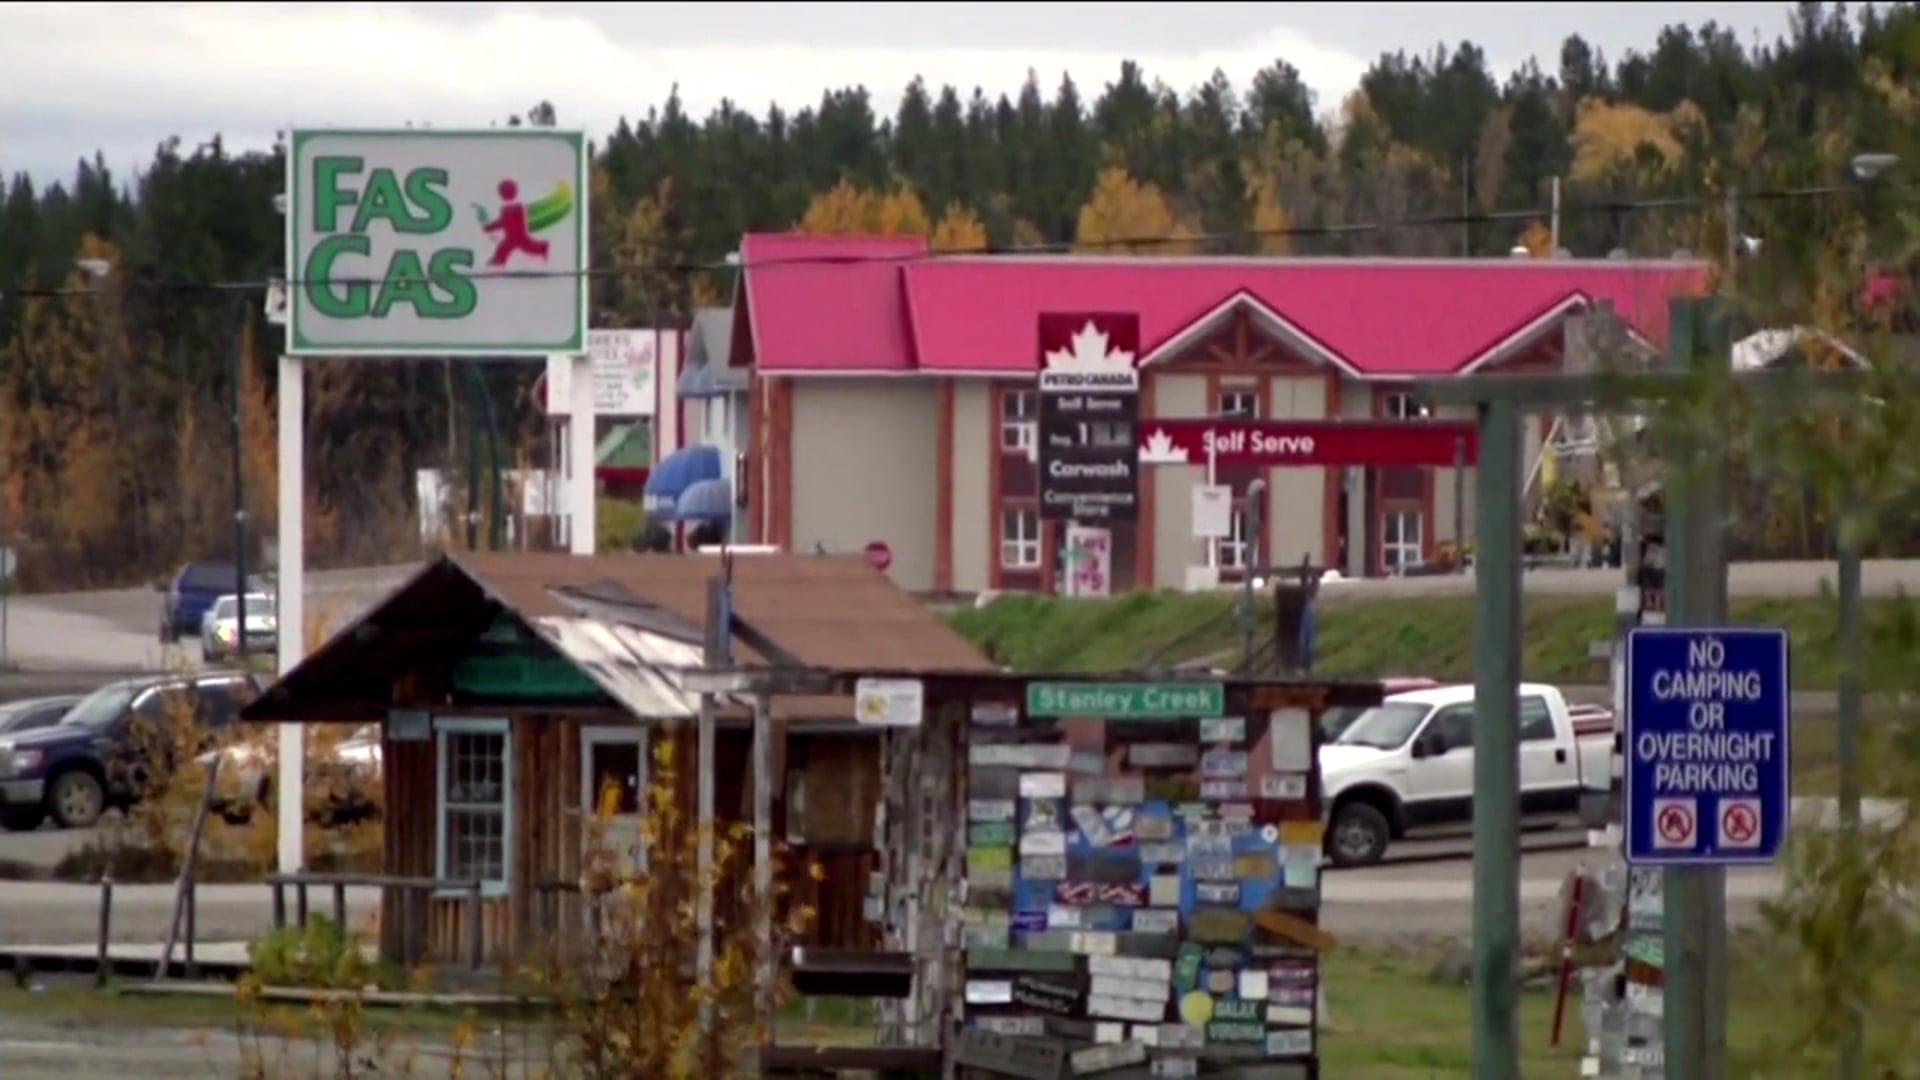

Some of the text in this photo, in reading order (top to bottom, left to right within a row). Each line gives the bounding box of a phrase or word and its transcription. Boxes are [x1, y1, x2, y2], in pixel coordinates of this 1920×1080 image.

[313, 156, 453, 234] FAS
[304, 234, 477, 318] GAS
[1202, 429, 1315, 453] Self Serve
[1049, 459, 1129, 478] Carwash
[1044, 489, 1134, 503] Convenience
[1689, 640, 1725, 669] NO
[1653, 670, 1761, 699] CAMPING
[1039, 688, 1213, 713] Stanley Creek
[1690, 702, 1725, 730] OR
[1638, 732, 1774, 761] OVERNIGHT
[1655, 763, 1758, 791] PARKING
